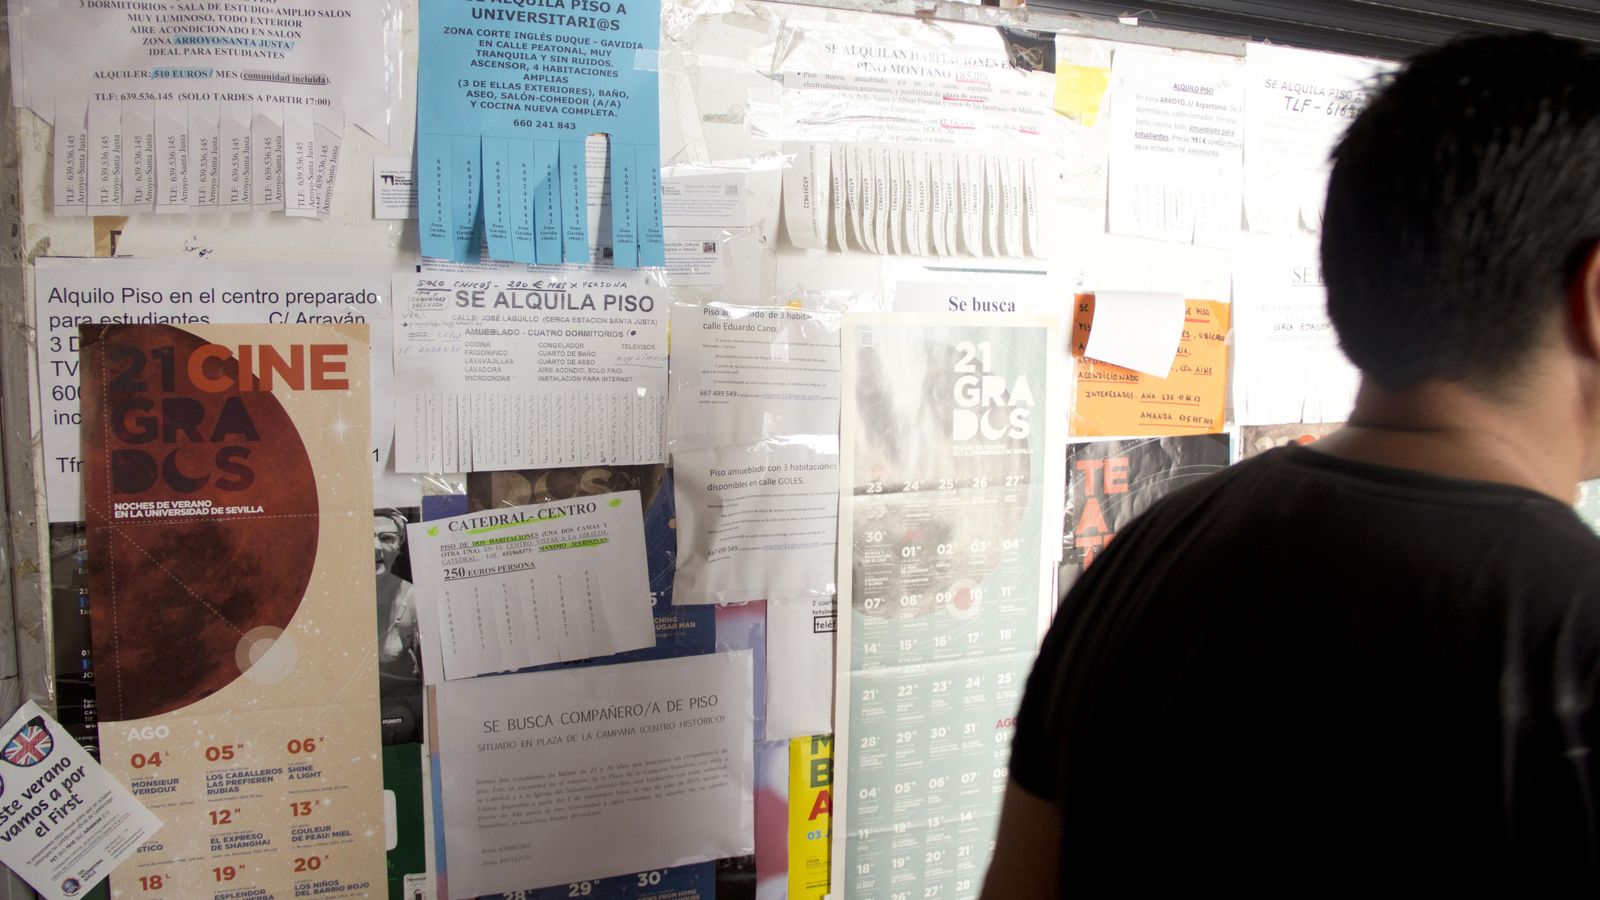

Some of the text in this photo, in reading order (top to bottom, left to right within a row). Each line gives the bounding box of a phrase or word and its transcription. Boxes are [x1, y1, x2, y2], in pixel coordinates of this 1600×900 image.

[87, 0, 167, 10] DORMITORIOS
[571, 0, 627, 14] PISO A
[127, 14, 152, 22] MUY
[217, 14, 247, 23] TODO
[250, 17, 302, 28] EXTERIOR
[472, 8, 620, 31] UNIVERSITARI@S
[158, 25, 249, 34] ACONDICIONADO
[267, 30, 301, 38] SALON
[443, 27, 643, 49] ZONA CORTE INGLÉS DUQUE GAVIDIA
[174, 36, 256, 46] ARROYO/SANTA
[259, 41, 290, 49] JUSTA
[496, 41, 528, 49] CALLE
[532, 44, 587, 56] PEATONAL,
[215, 48, 285, 59] ESTUDIANTES
[476, 50, 537, 60] TRANQUILA
[550, 55, 568, 63] SIN
[470, 59, 618, 77] ASCENSOR, HABITACIONES
[93, 70, 151, 79] ALQUILER:
[216, 70, 238, 78] MES
[240, 72, 290, 83] (comunidad
[523, 74, 568, 83] AMPLIAS
[458, 79, 469, 88] (3
[490, 82, 521, 91] ELLAS
[525, 84, 595, 97] EXTERIORES),
[599, 89, 629, 100] BAÑO,
[1281, 81, 1325, 96] ALQUILA
[178, 92, 210, 101] (SOLO
[213, 93, 254, 102] TARDES
[266, 95, 302, 104] PARTIR
[466, 90, 621, 109] ASEO, SALÓN-COMEDOR (A/A)
[1285, 96, 1312, 112] TLF
[480, 101, 618, 117] COCINA NUEVA COMPLETA.
[513, 119, 532, 127] 660
[48, 287, 378, 308] Alquilo Piso en el centro preparado
[455, 290, 654, 312] SE ALQUILA PISO
[949, 296, 1016, 312] Se busca
[703, 308, 719, 316] Piso
[565, 330, 623, 338] DORMITORIOS
[723, 322, 755, 332] Eduardo
[954, 341, 991, 373] 21
[109, 343, 350, 393] 21 CINE
[954, 375, 1035, 407] GRA
[111, 396, 261, 444] GRA
[728, 465, 765, 476] amueblado
[707, 479, 748, 492] disponibles
[759, 478, 776, 486] calle
[114, 500, 212, 510] NOCHES DE VERANO
[115, 505, 264, 519] EN LA UNIVERSIDAD DE SEVILLA
[538, 502, 596, 520] CENTRO
[443, 562, 536, 580] 250 EUROS PERSONA
[483, 694, 718, 734] SE BUSCA COMPAÑERO/A DE PISO
[127, 725, 170, 742] AGO
[477, 727, 636, 752] SITUADO PLAZA CAMPANA
[206, 745, 234, 762] 05
[288, 738, 316, 754] 06
[130, 751, 162, 769] 04
[206, 773, 224, 782] LOS
[225, 768, 284, 780] CABALLEROS
[288, 764, 313, 773] SHINE
[297, 771, 322, 780] LIGHT
[21, 756, 71, 800] verano
[132, 778, 179, 788] MONSIEUR
[225, 776, 274, 787] PREFIEREN
[132, 786, 176, 796] VERDOUX
[207, 786, 240, 796] RUBIAS
[0, 765, 86, 842] vamos por
[50, 793, 84, 825] First
[290, 801, 312, 817] 13
[209, 810, 232, 825] 12
[224, 832, 263, 844] EXPRESO
[292, 826, 331, 836] COULEUR
[332, 830, 351, 838] MIEL
[224, 839, 270, 850] SHANGHAI
[294, 856, 321, 872] 20
[212, 866, 236, 882] 19
[139, 875, 162, 891] 18
[312, 882, 369, 896] BARRIO ROJO
[313, 879, 339, 889] NIÑOS
